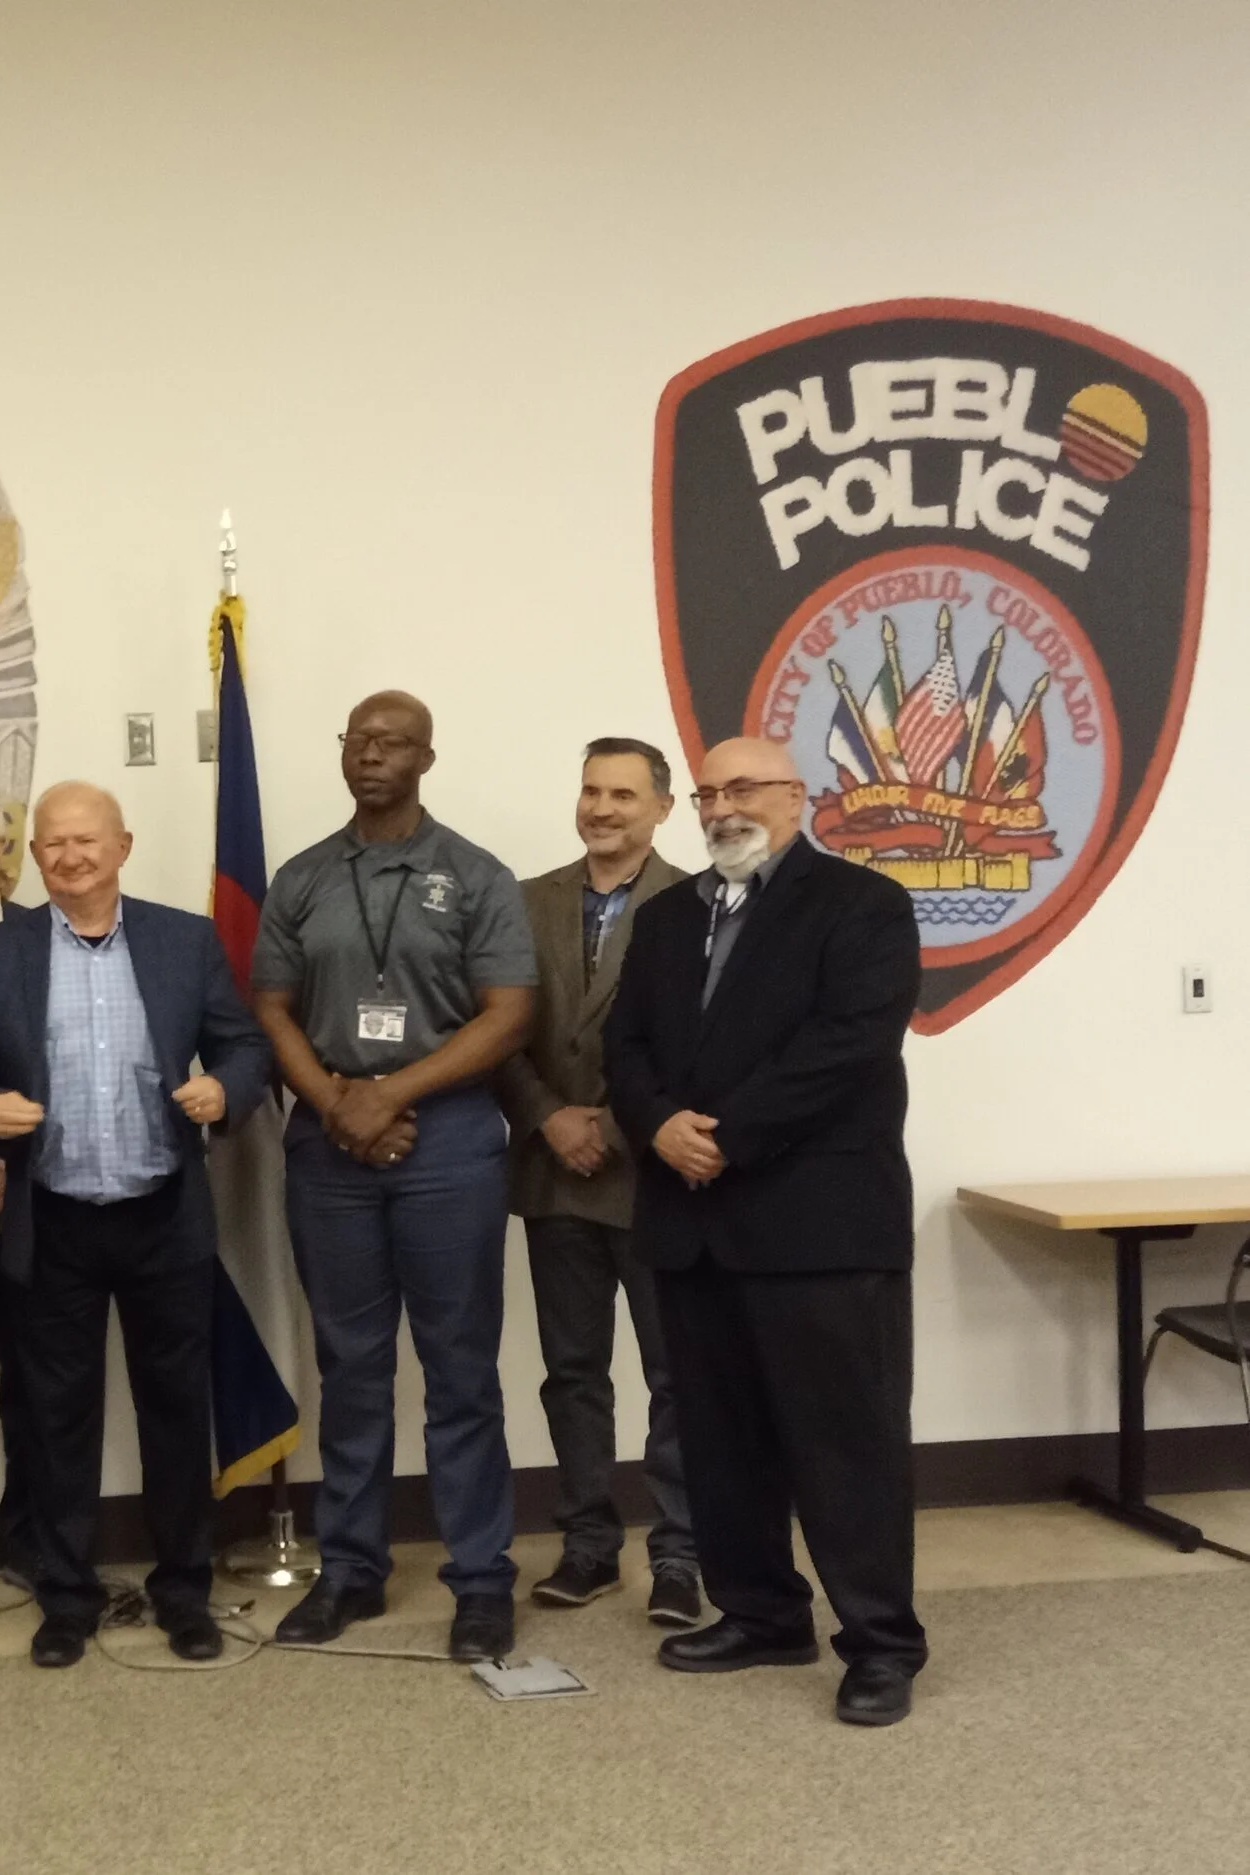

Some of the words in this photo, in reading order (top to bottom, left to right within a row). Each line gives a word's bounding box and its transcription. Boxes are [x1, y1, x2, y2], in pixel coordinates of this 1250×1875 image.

[759, 449, 1109, 571] POLICE
[765, 655, 810, 743] CITY
[801, 615, 838, 658] OF
[987, 584, 1099, 746] COLORADO
[922, 792, 967, 817] FIVE
[978, 806, 1042, 829] FLAGS
